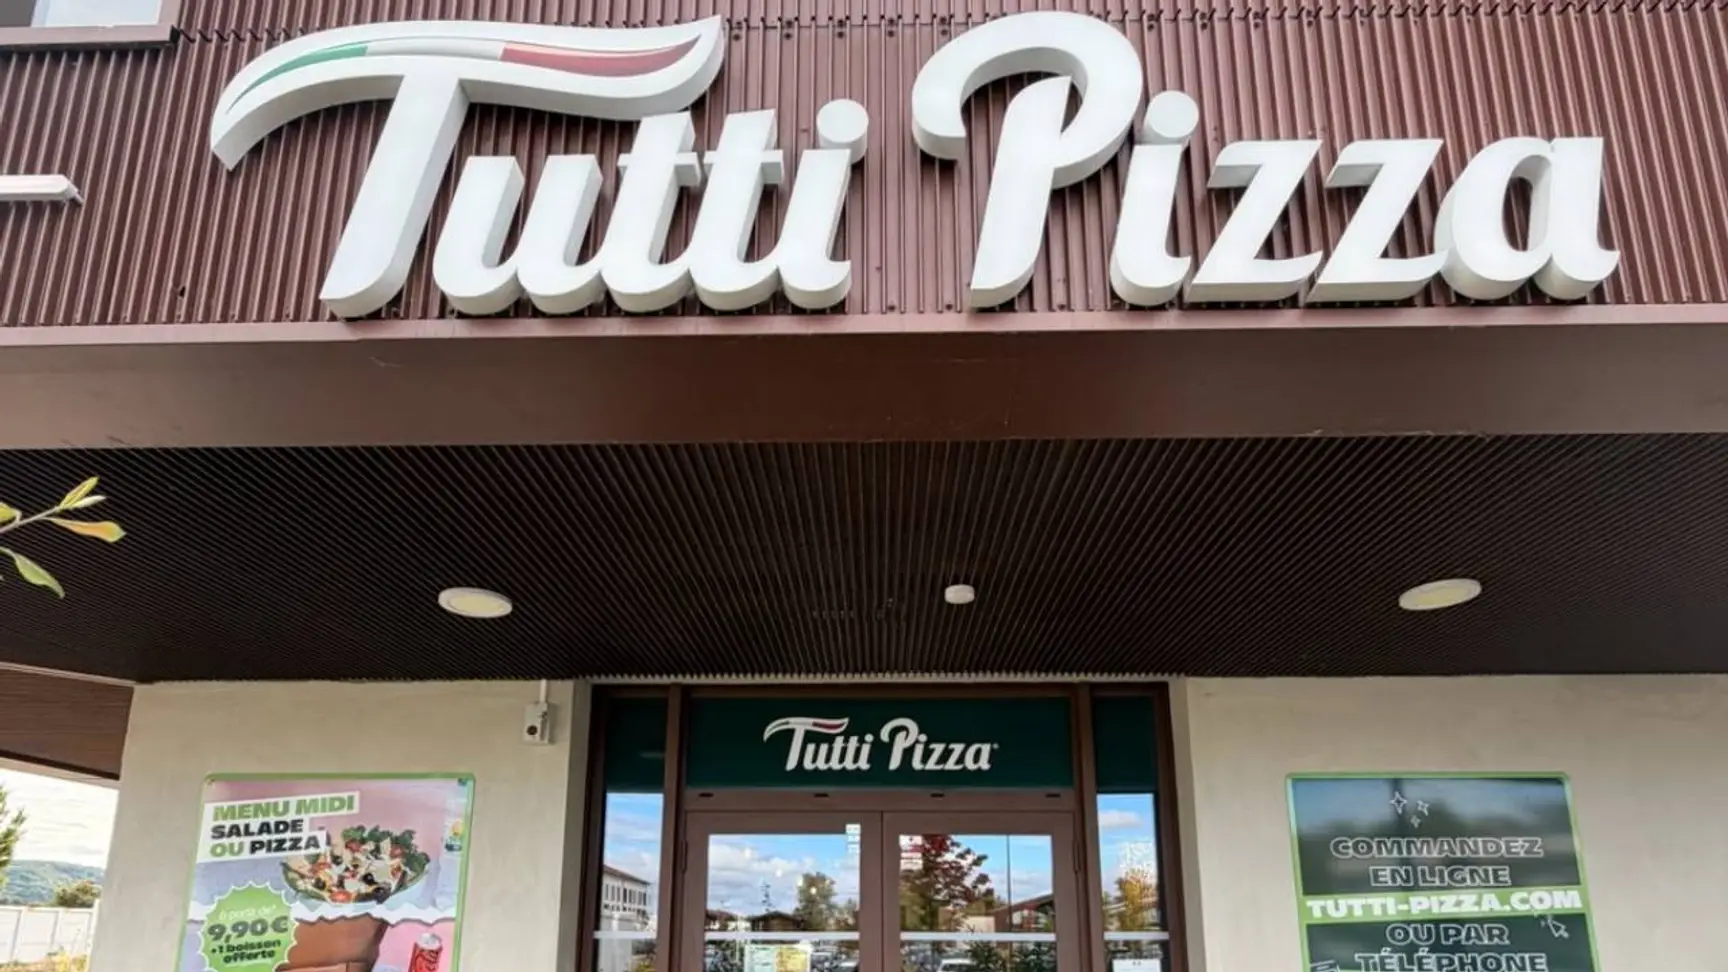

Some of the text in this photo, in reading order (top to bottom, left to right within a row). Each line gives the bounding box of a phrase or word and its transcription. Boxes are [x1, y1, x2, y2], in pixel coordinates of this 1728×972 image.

[210, 11, 1620, 318] Tutti Pizza
[763, 716, 874, 771] Tutti
[214, 795, 355, 820] MENU MIDI
[211, 820, 303, 839] SALADE
[209, 836, 320, 857] OU PIZZA
[1330, 837, 1544, 858] COMMANDEZ
[1369, 866, 1512, 887] EN LIGNE
[1306, 890, 1582, 918] TUTTI-PIZZA.COM
[207, 916, 288, 943] 9,90€
[1386, 923, 1510, 945] OU PAR
[223, 950, 275, 963] offerte
[226, 940, 281, 952] boisson
[1354, 947, 1548, 972] TÉLÉPHONE
